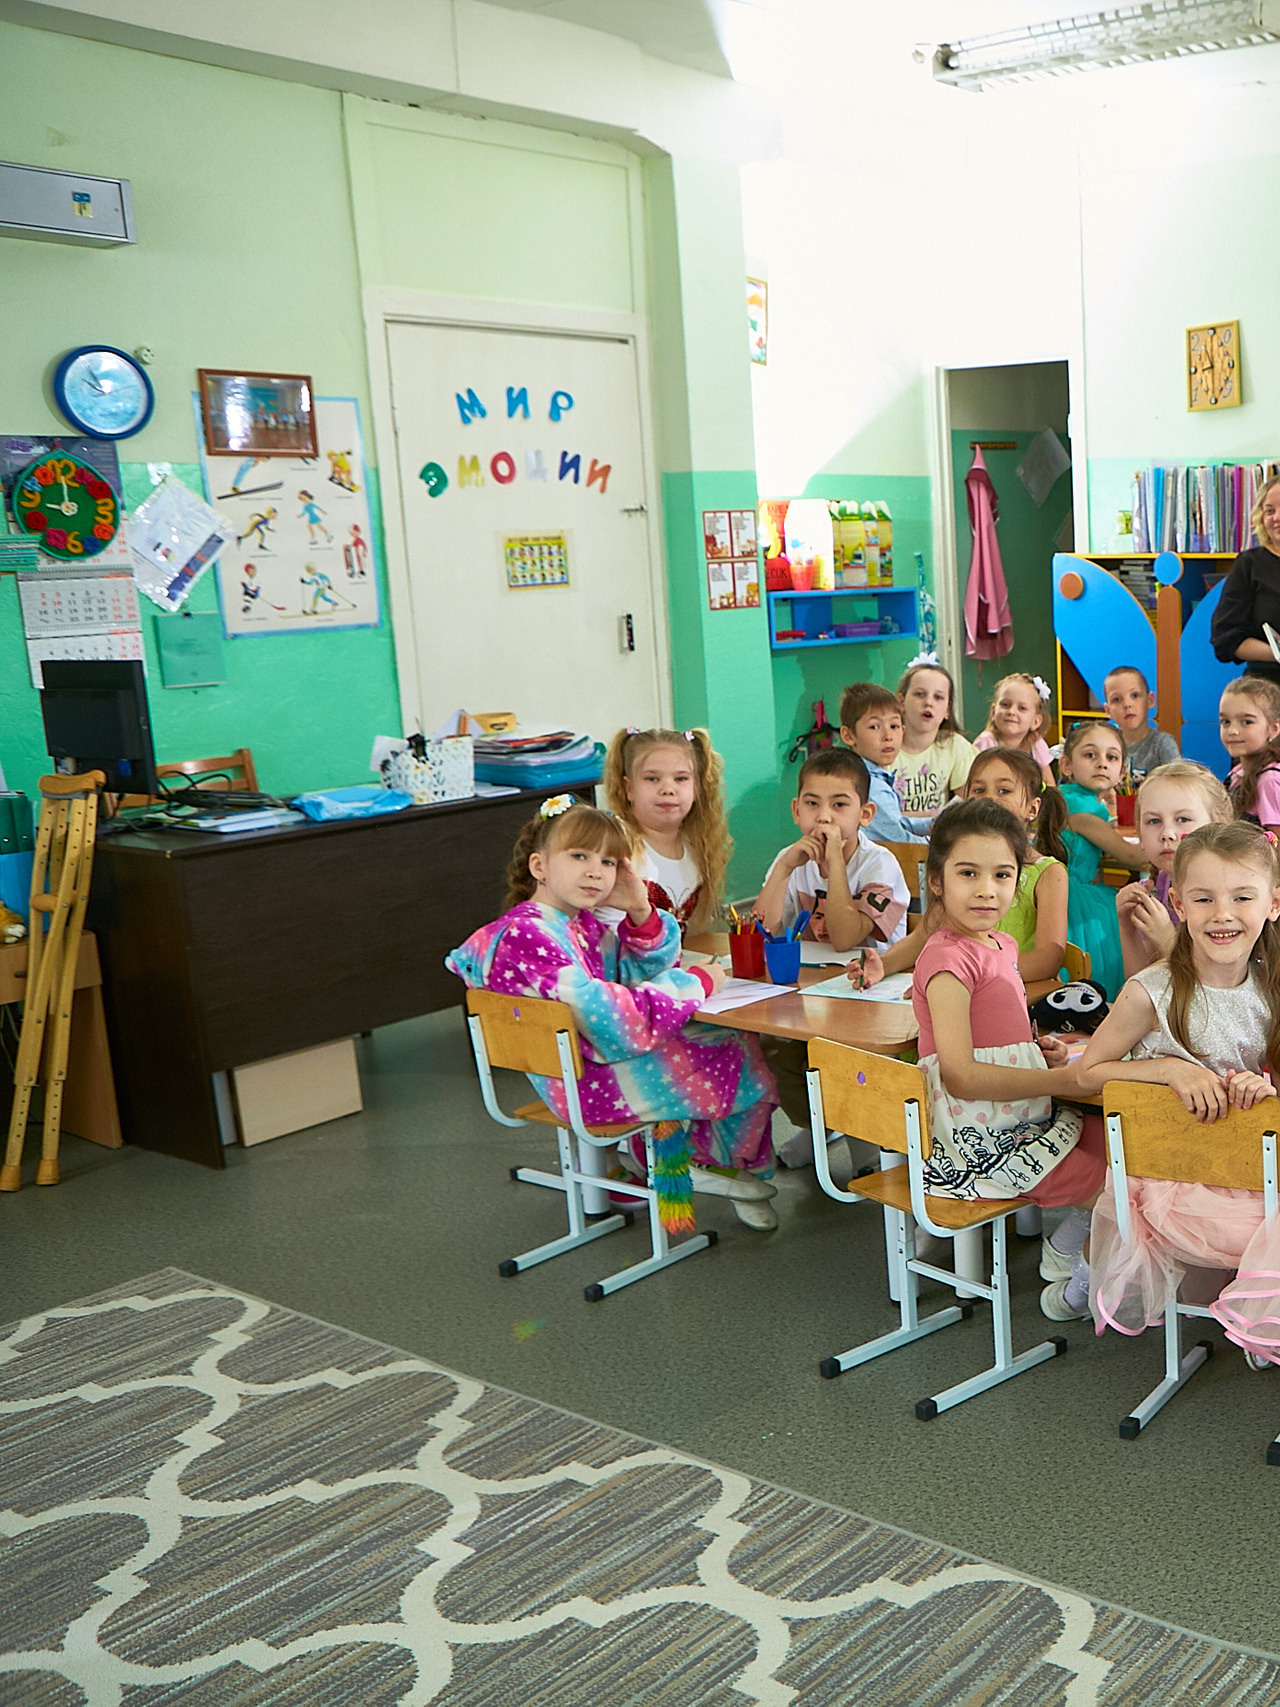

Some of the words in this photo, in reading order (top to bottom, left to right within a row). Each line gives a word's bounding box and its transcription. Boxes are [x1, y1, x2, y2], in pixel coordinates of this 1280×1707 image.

[1190, 333, 1200, 352] 2
[1223, 329, 1232, 344] 0
[1192, 386, 1198, 402] 1
[1222, 380, 1233, 399] 9
[456, 386, 574, 425] МИР
[419, 450, 611, 498] ЭМОЦИИ
[94, 498, 115, 524] 3
[66, 531, 84, 554] 6
[766, 567, 788, 579] ЕСОК
[905, 773, 937, 796] THIS
